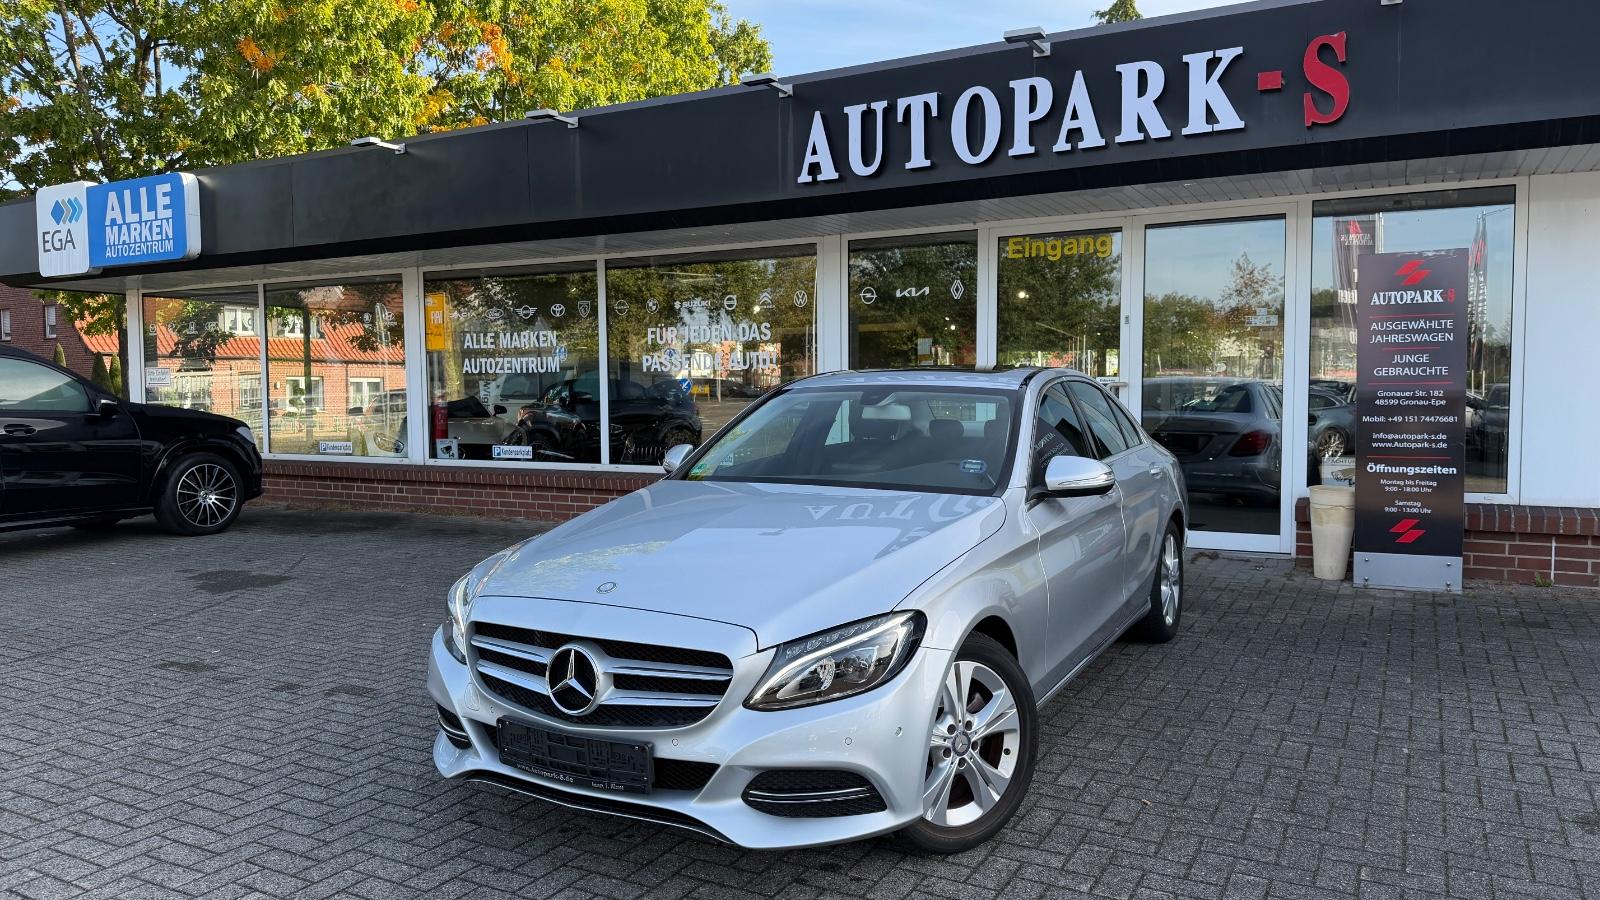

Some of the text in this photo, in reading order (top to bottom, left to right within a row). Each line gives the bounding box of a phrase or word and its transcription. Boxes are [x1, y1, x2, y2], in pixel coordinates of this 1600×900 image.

[105, 183, 172, 226] ALLE
[105, 219, 173, 246] MARKEN
[42, 228, 76, 254] EGA
[105, 240, 174, 258] AUTOZENTRUM
[1007, 235, 1113, 261] Eingang
[1370, 319, 1454, 331] AUSGEWÄHLTE
[647, 322, 772, 345] FÜR JEDEN DAS
[1369, 332, 1454, 344] JAHRESWAGEN
[464, 330, 557, 350] ALLE MARKEN
[642, 352, 722, 373] PASSENDE
[1392, 353, 1430, 364] JUNGE
[462, 356, 560, 374] AUTOZENTRUM
[1373, 366, 1449, 377] GEBRAUCHTE
[1399, 399, 1447, 407] Gronau-Epe
[1362, 415, 1458, 423] Mobil: +49 151 74476681
[1372, 432, 1447, 441] info@autopark-s.de
[1371, 441, 1448, 450] www.Autopark-s.de
[1366, 462, 1457, 475] Öffnungszeiten
[1380, 479, 1404, 487] Montag
[1415, 479, 1438, 487] Freitag
[1394, 500, 1422, 508] Samstag
